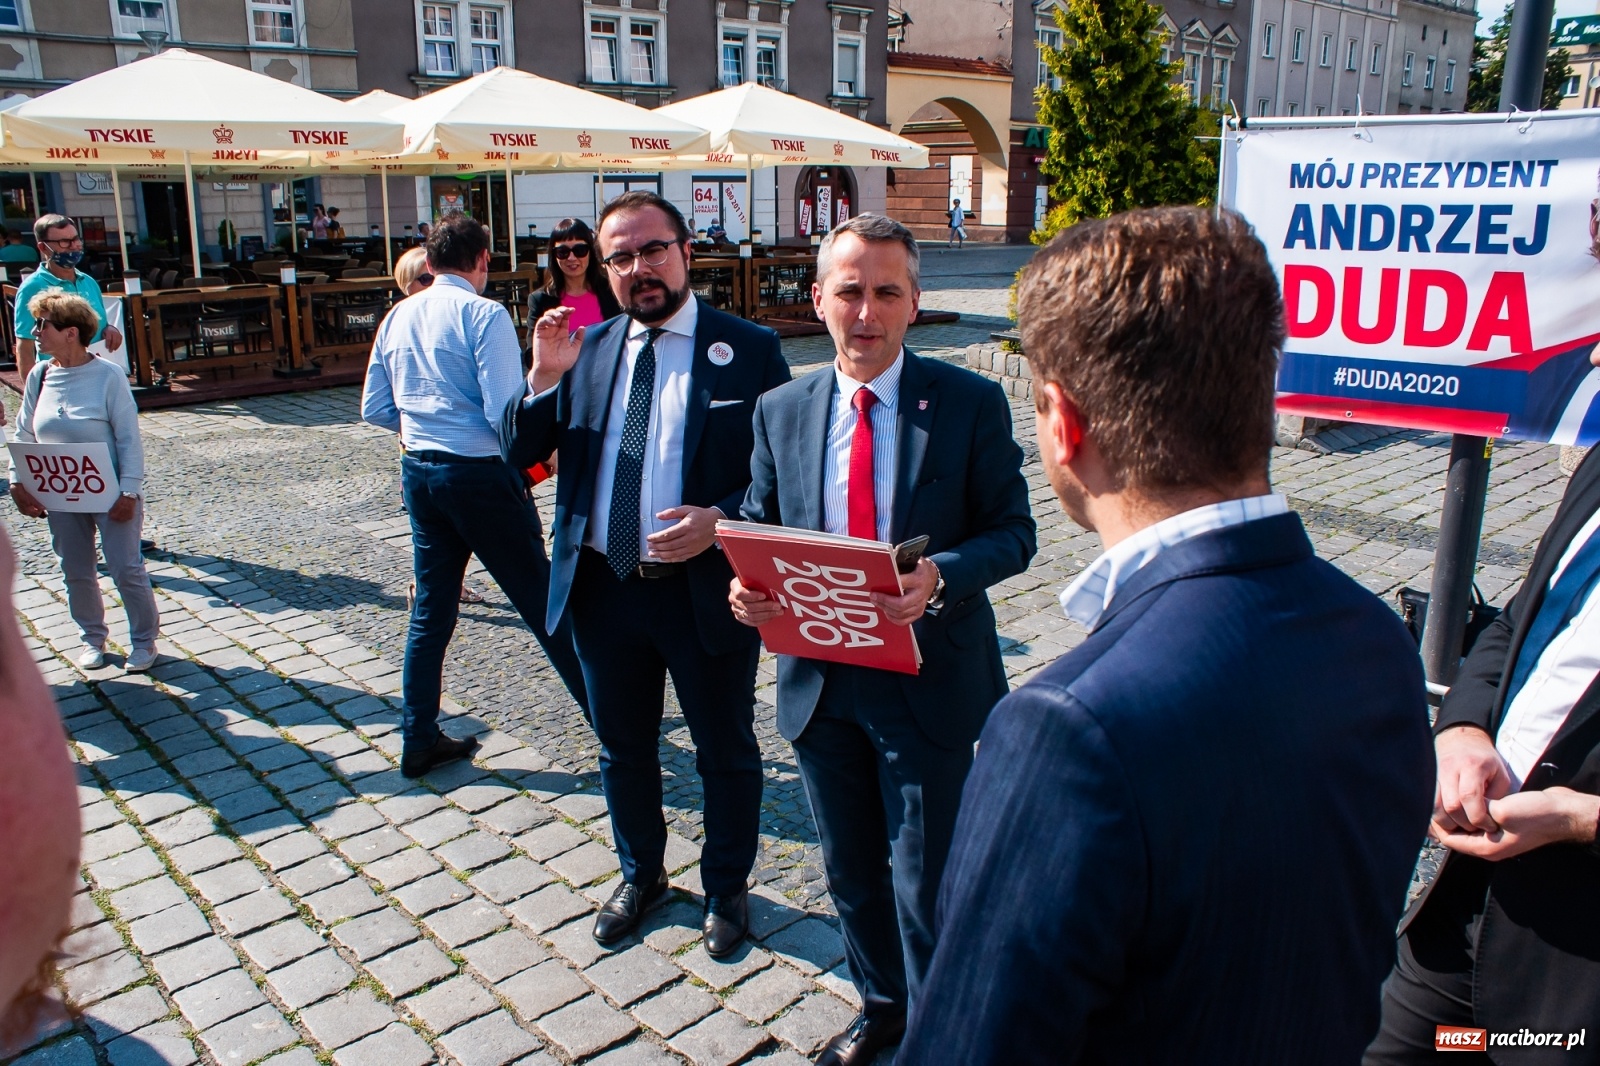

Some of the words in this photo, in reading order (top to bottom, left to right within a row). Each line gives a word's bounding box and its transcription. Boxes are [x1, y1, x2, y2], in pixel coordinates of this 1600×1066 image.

[84, 129, 155, 143] TYSKIE
[289, 130, 349, 145] TYSKIE
[490, 133, 538, 147] TYSKIE
[629, 137, 672, 150] TYSKIE
[771, 139, 806, 152] TYSKIE
[870, 148, 902, 162] TYSKIE
[1290, 158, 1355, 189] MÓJ
[1360, 159, 1559, 189] PREZYDENT
[694, 188, 713, 202] 64
[1283, 203, 1551, 256] ANDRZEJ
[1283, 264, 1534, 352] DUDA
[347, 313, 375, 324] TYSKIE
[203, 325, 235, 337] TYSKIE
[1333, 366, 1460, 397] #DUDA2020
[25, 455, 100, 475] DUDA
[34, 474, 105, 494] 2020
[772, 556, 843, 646] 2020
[818, 565, 885, 649] DUDA
